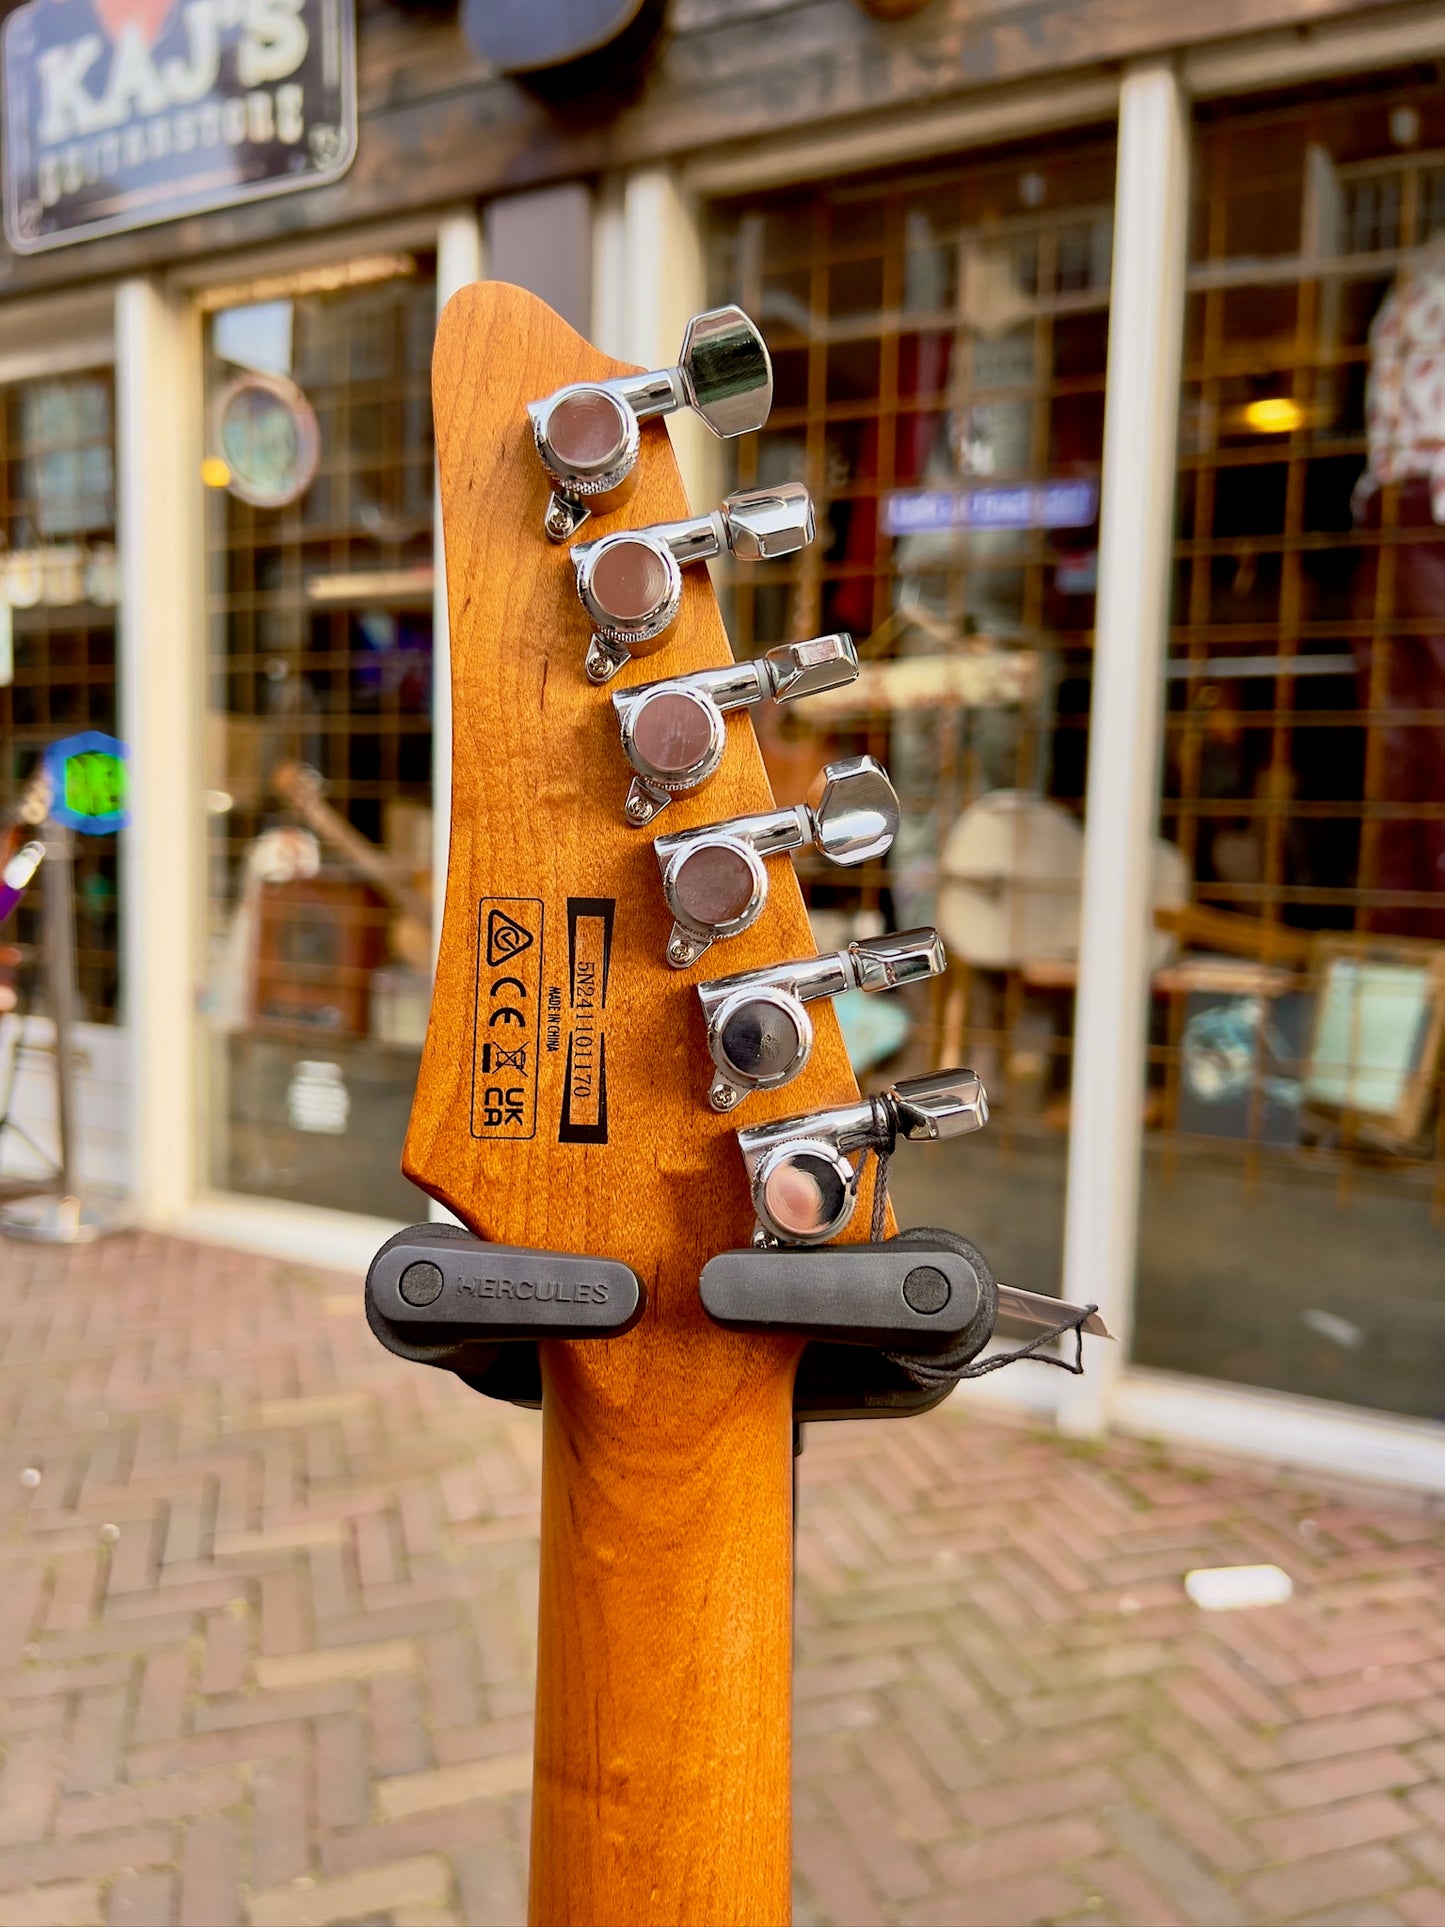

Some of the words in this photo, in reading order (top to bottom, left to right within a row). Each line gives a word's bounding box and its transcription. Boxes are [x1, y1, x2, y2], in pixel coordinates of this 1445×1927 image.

[37, 0, 309, 146] KAJ'S
[548, 986, 561, 1011] MADE
[548, 1013, 560, 1023] IN
[573, 961, 595, 1098] 5N241101170
[547, 1025, 560, 1052] CHINA
[483, 1087, 503, 1126] CA
[505, 1087, 524, 1126] UK
[456, 1275, 610, 1305] HERCULES
